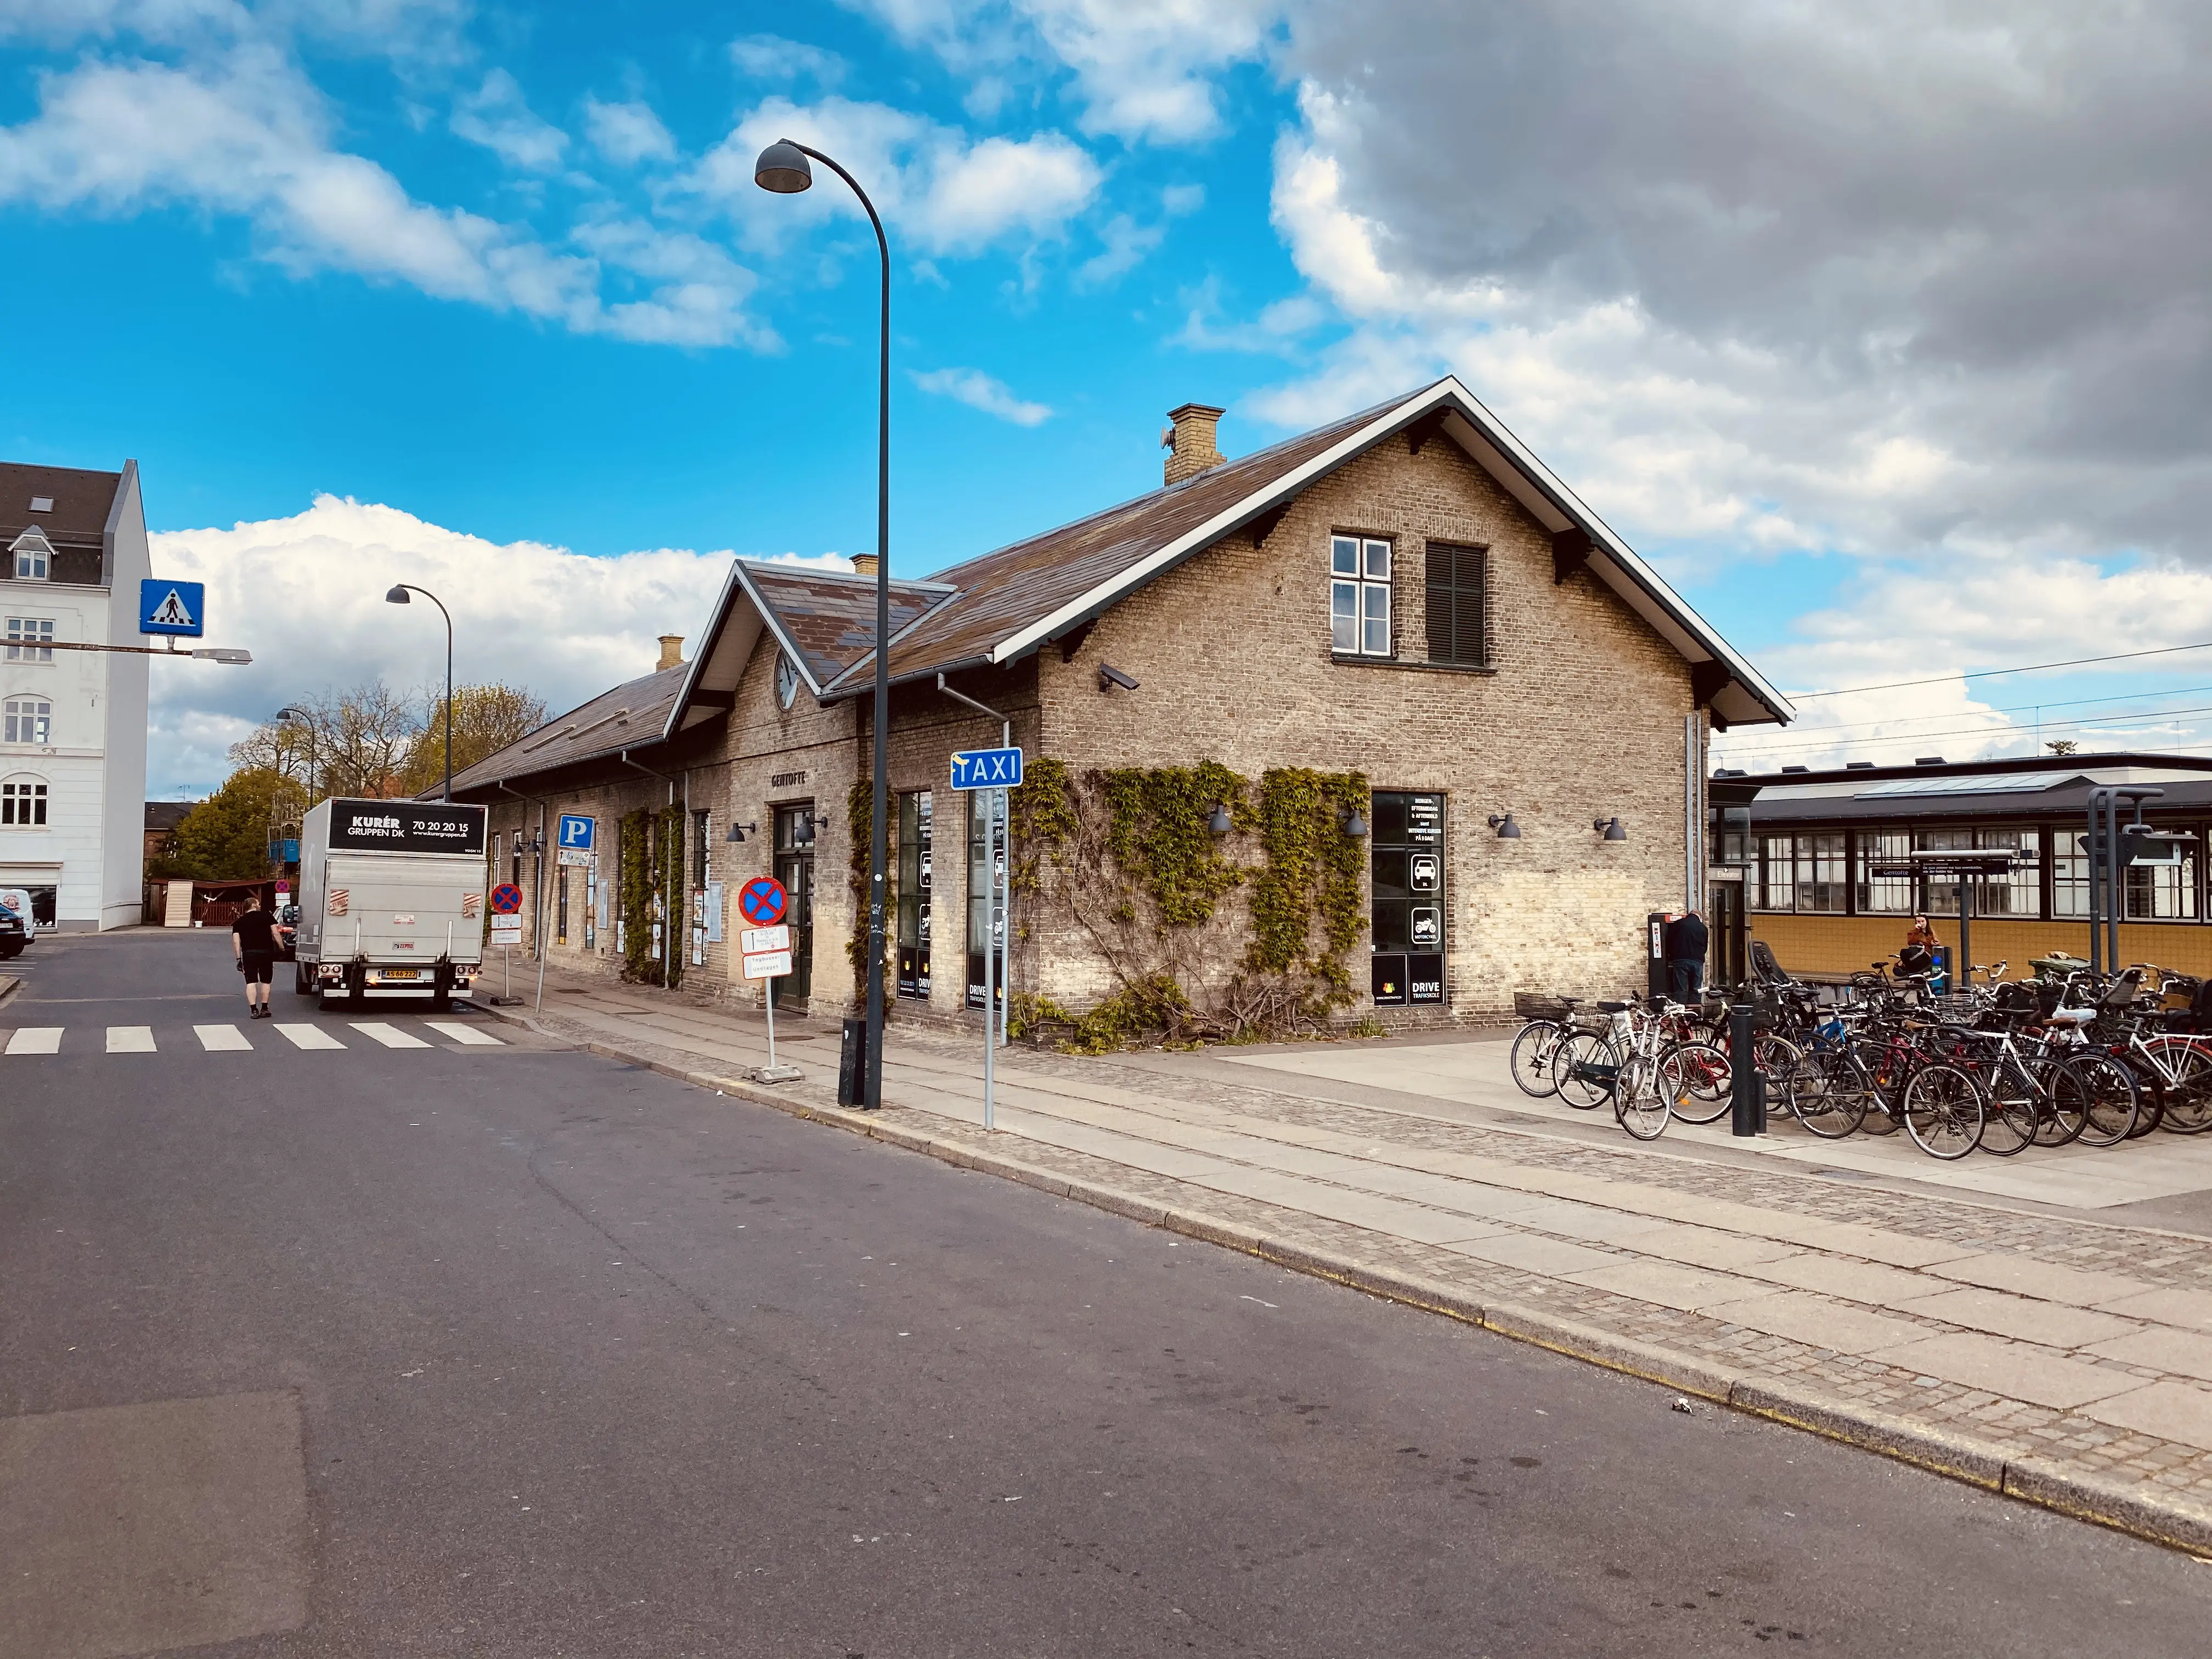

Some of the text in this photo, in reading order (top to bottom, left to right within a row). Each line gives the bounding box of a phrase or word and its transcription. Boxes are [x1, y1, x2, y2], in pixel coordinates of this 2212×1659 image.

[957, 755, 1015, 782] TAXI
[772, 771, 805, 787] GENTOFTE
[352, 815, 400, 828] KURÉR
[413, 821, 469, 832] 70 20 20 15
[347, 827, 405, 838] GRUPPEN DK
[565, 820, 587, 843] P
[919, 978, 930, 988] DRIV
[1412, 982, 1440, 992] DRIVE
[970, 984, 985, 996] DRIVE
